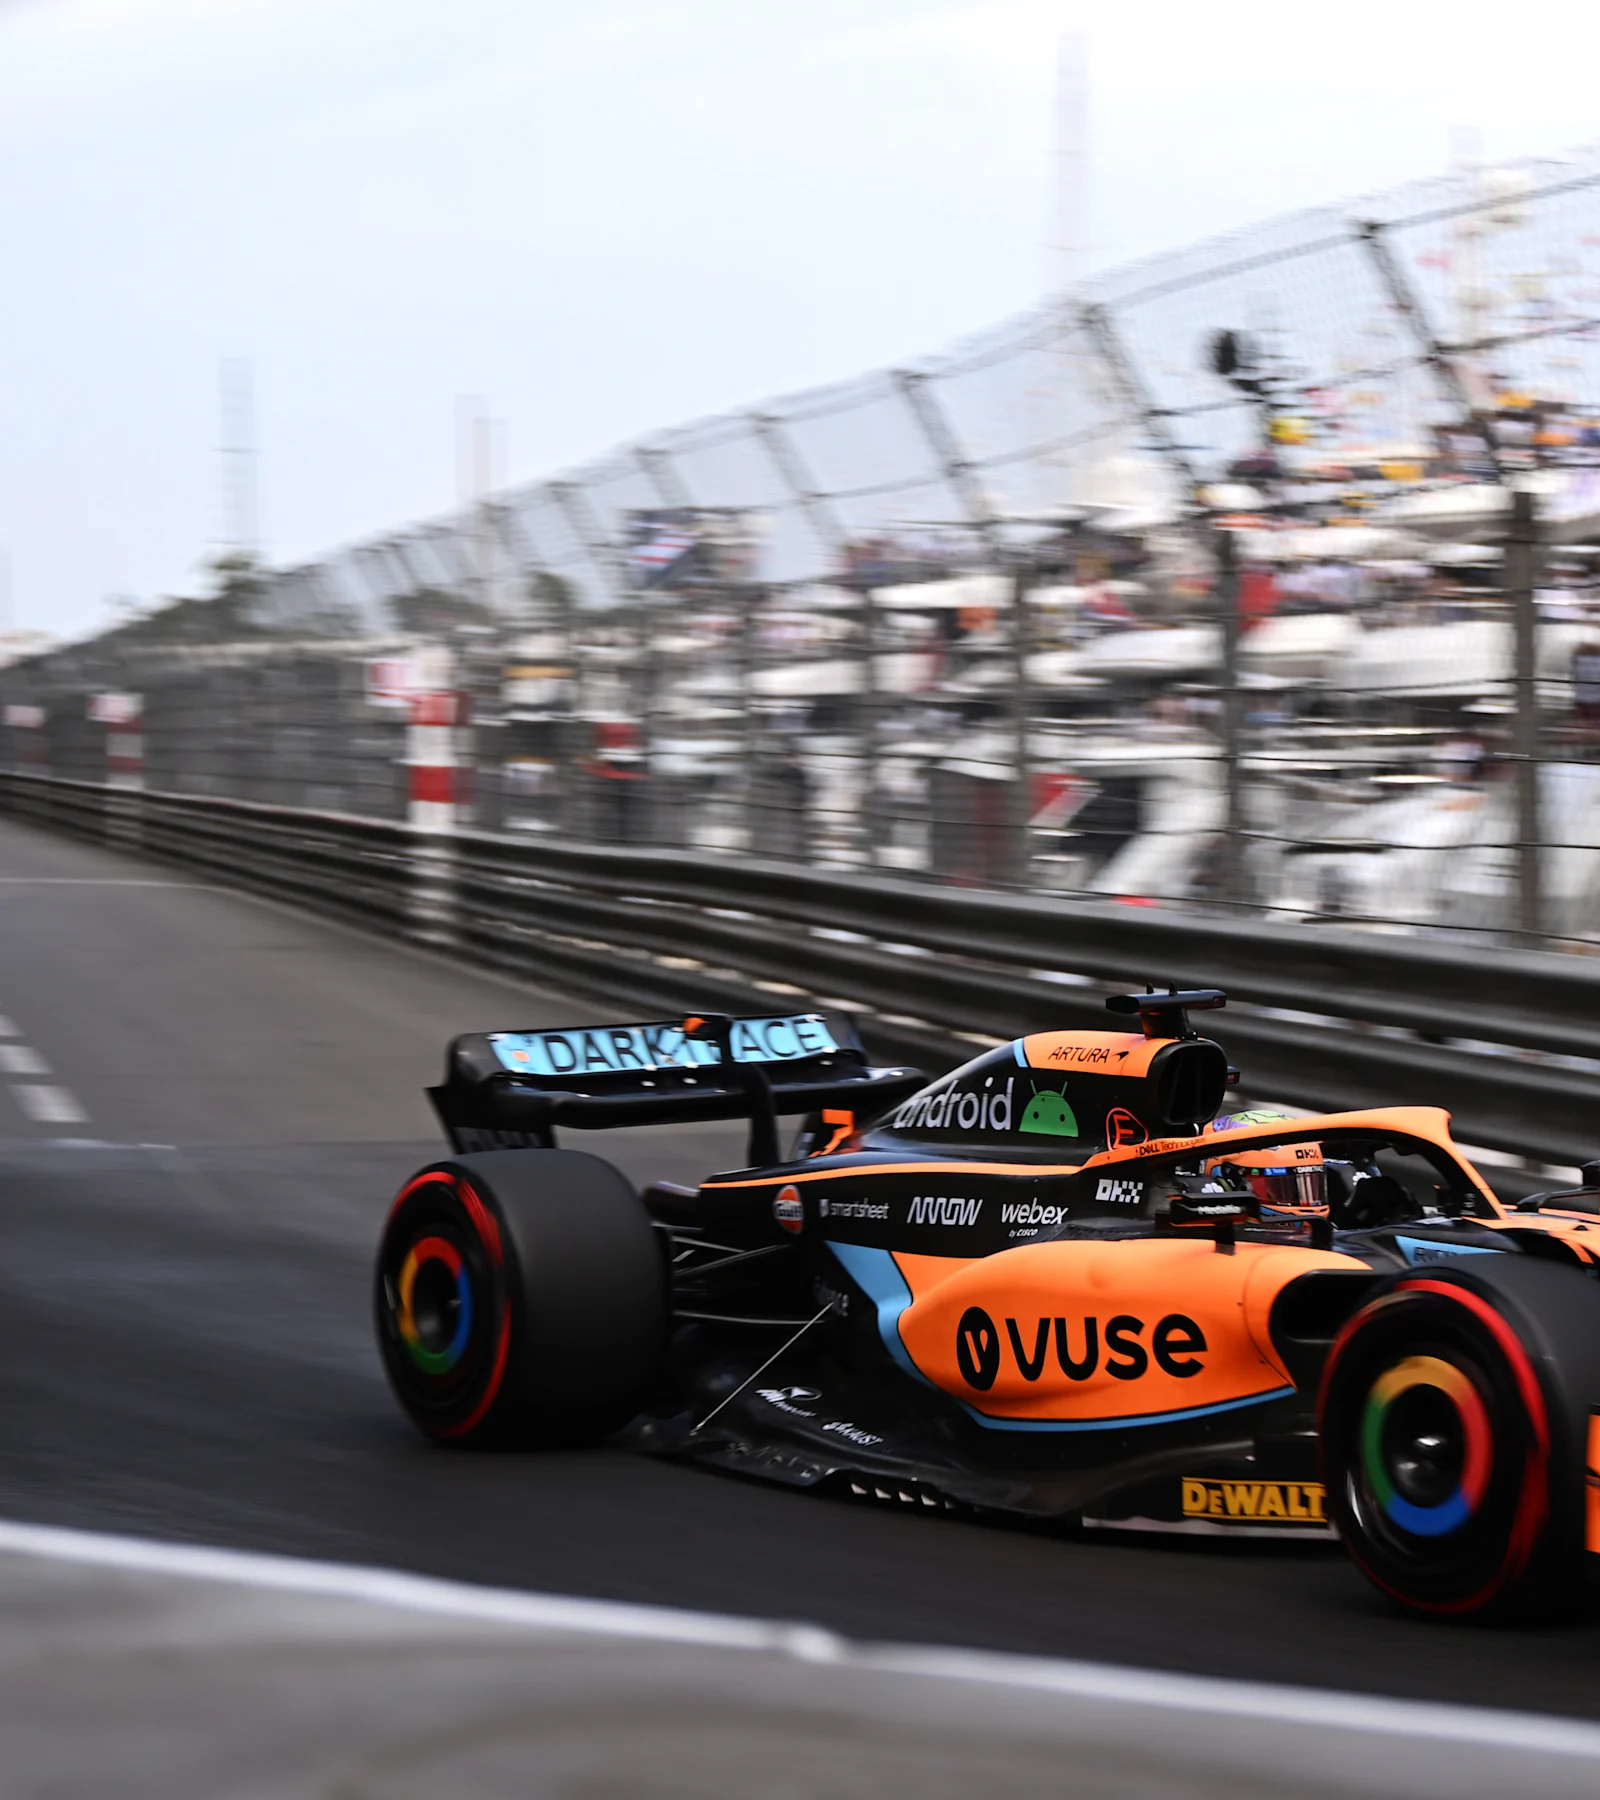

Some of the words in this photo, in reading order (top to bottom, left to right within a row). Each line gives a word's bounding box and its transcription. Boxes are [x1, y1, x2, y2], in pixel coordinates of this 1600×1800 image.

[540, 1015, 825, 1073] DARKACE
[1048, 1046, 1112, 1064] ARTURA
[891, 1077, 1014, 1130] android
[831, 1198, 888, 1219] smartsheet
[1001, 1199, 1068, 1224] webex
